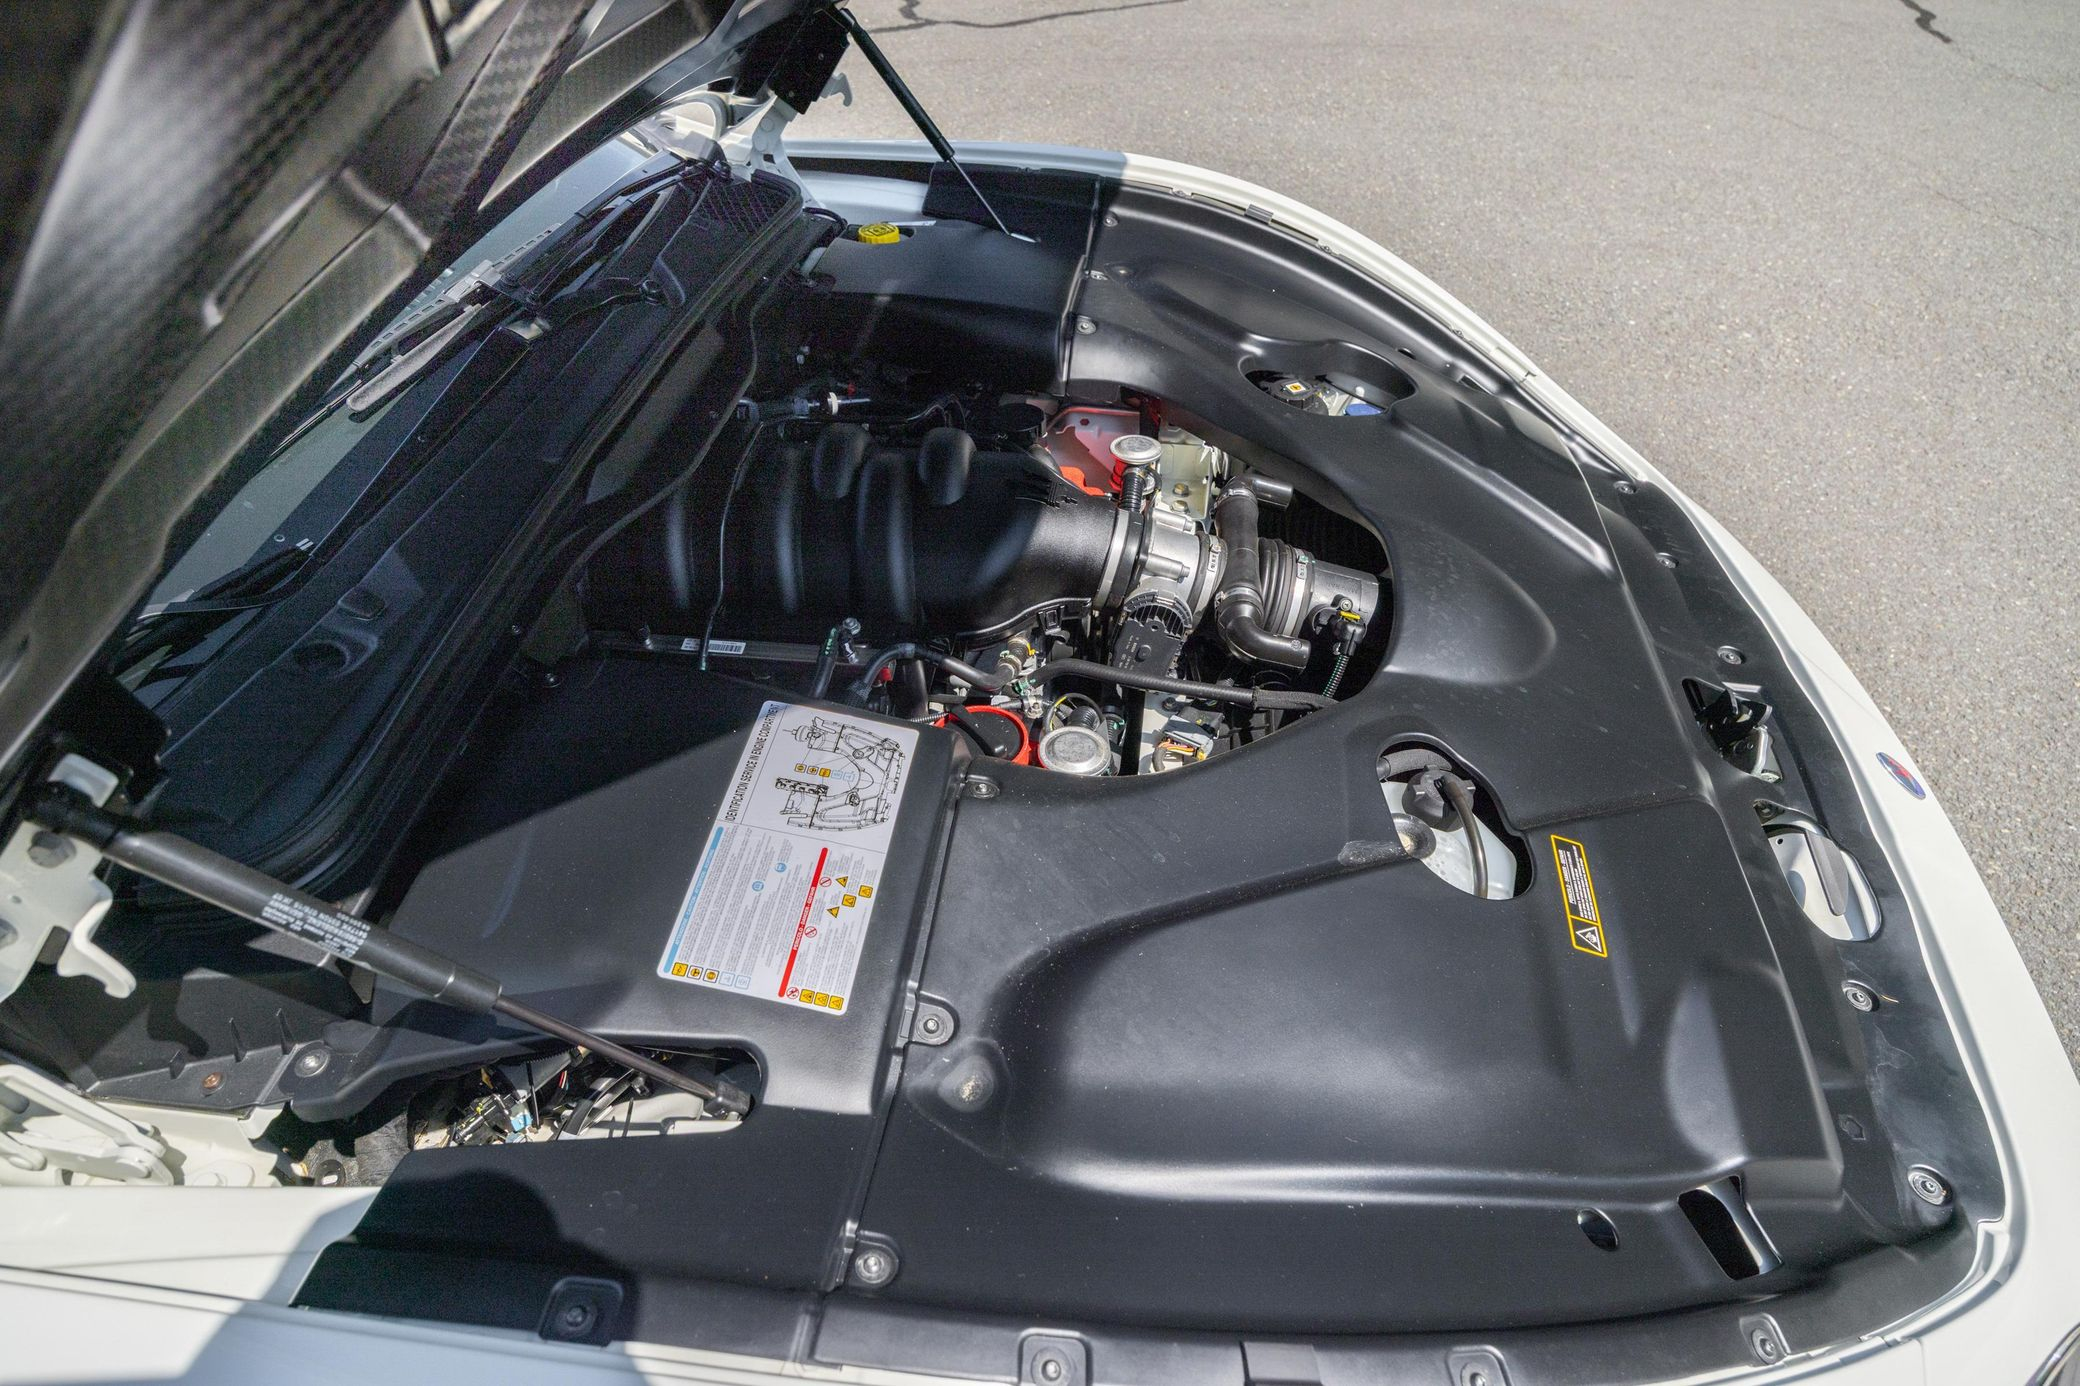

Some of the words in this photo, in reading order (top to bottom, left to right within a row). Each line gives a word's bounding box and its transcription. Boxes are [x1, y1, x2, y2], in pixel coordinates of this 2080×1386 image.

[758, 703, 779, 737] COMPARTMENT
[751, 736, 766, 755] ENGINE
[740, 760, 757, 782] SERVICE
[724, 781, 749, 822] IDENTIFICATION
